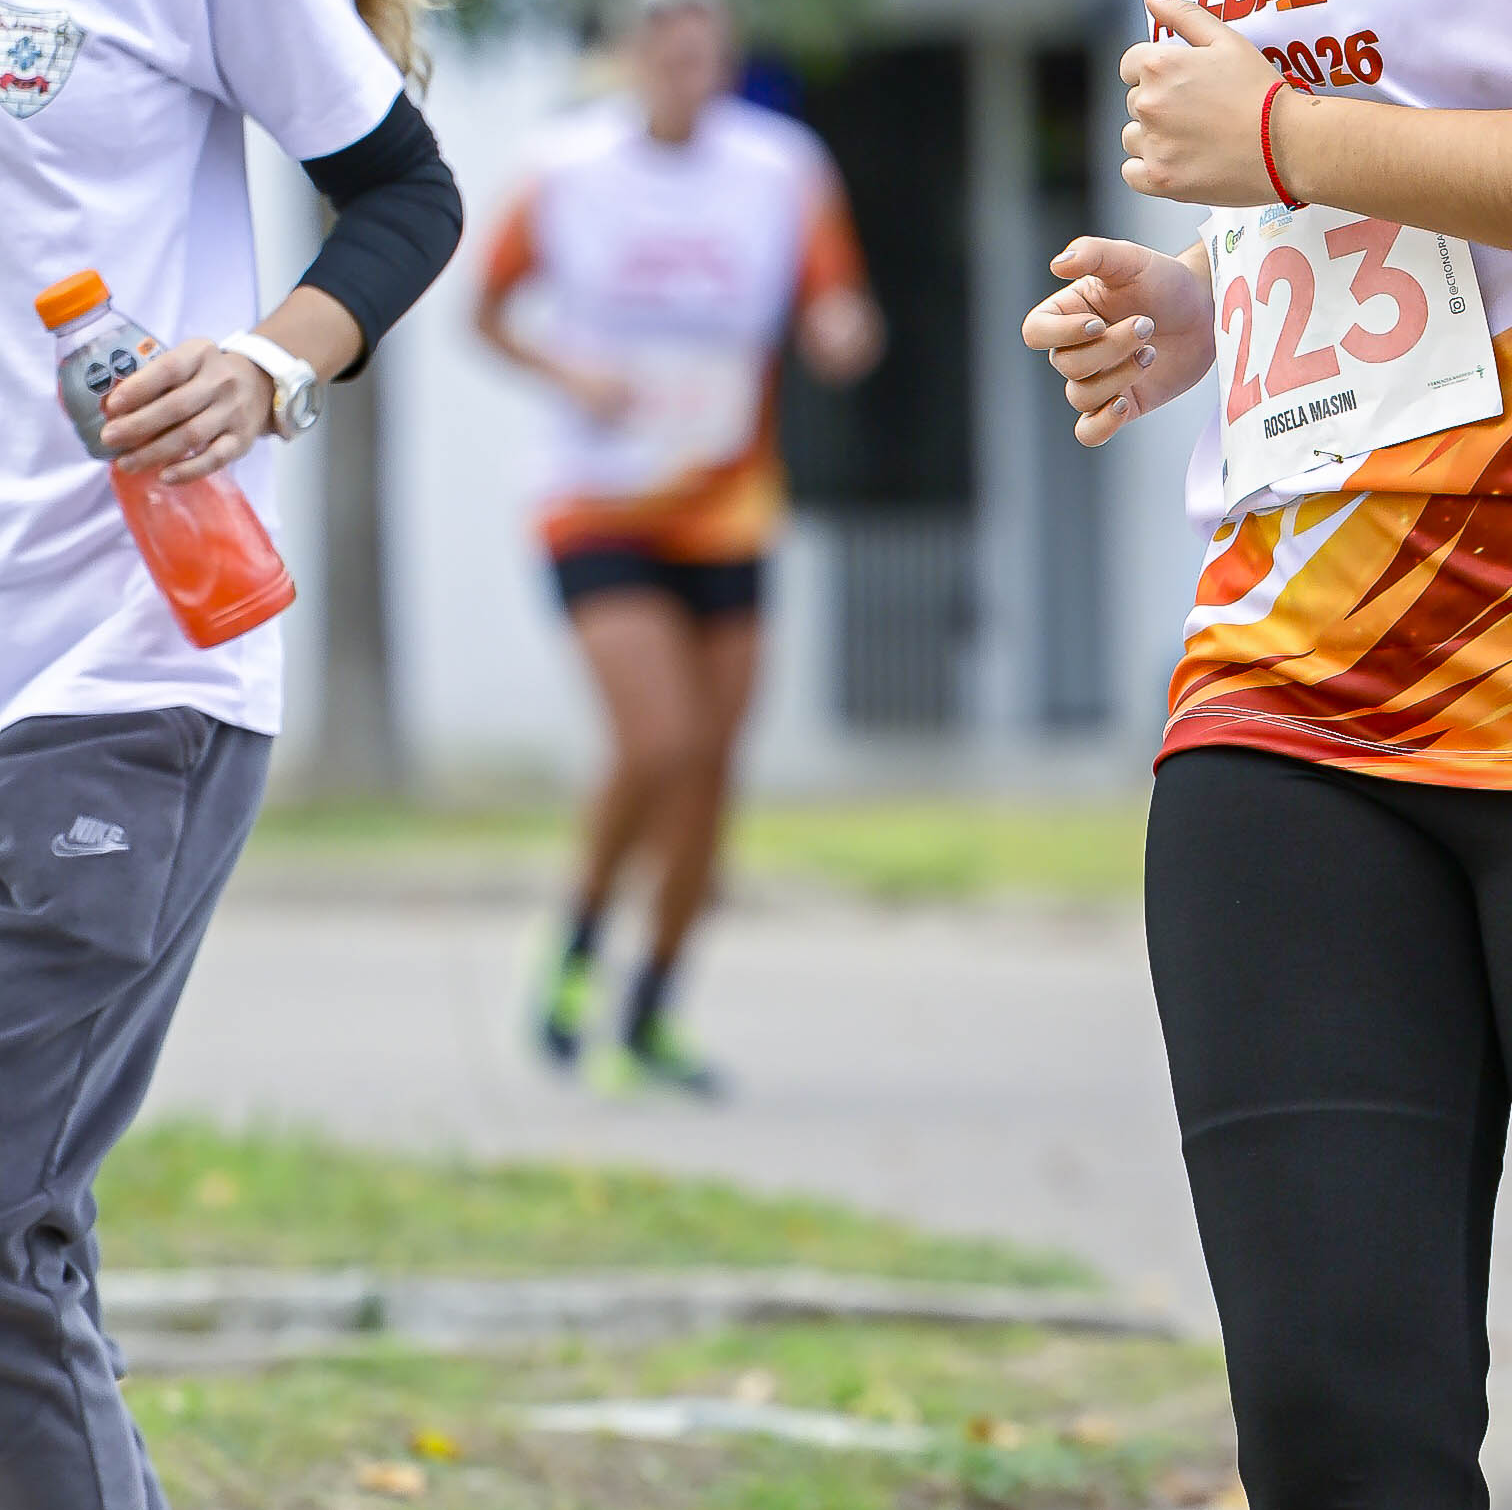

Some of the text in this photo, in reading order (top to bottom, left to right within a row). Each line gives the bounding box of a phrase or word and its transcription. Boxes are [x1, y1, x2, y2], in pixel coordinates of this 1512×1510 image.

[1435, 234, 1459, 295] @CRONORA
[1221, 217, 1429, 427] 223
[1263, 389, 1358, 439] ROSELA MASINI
